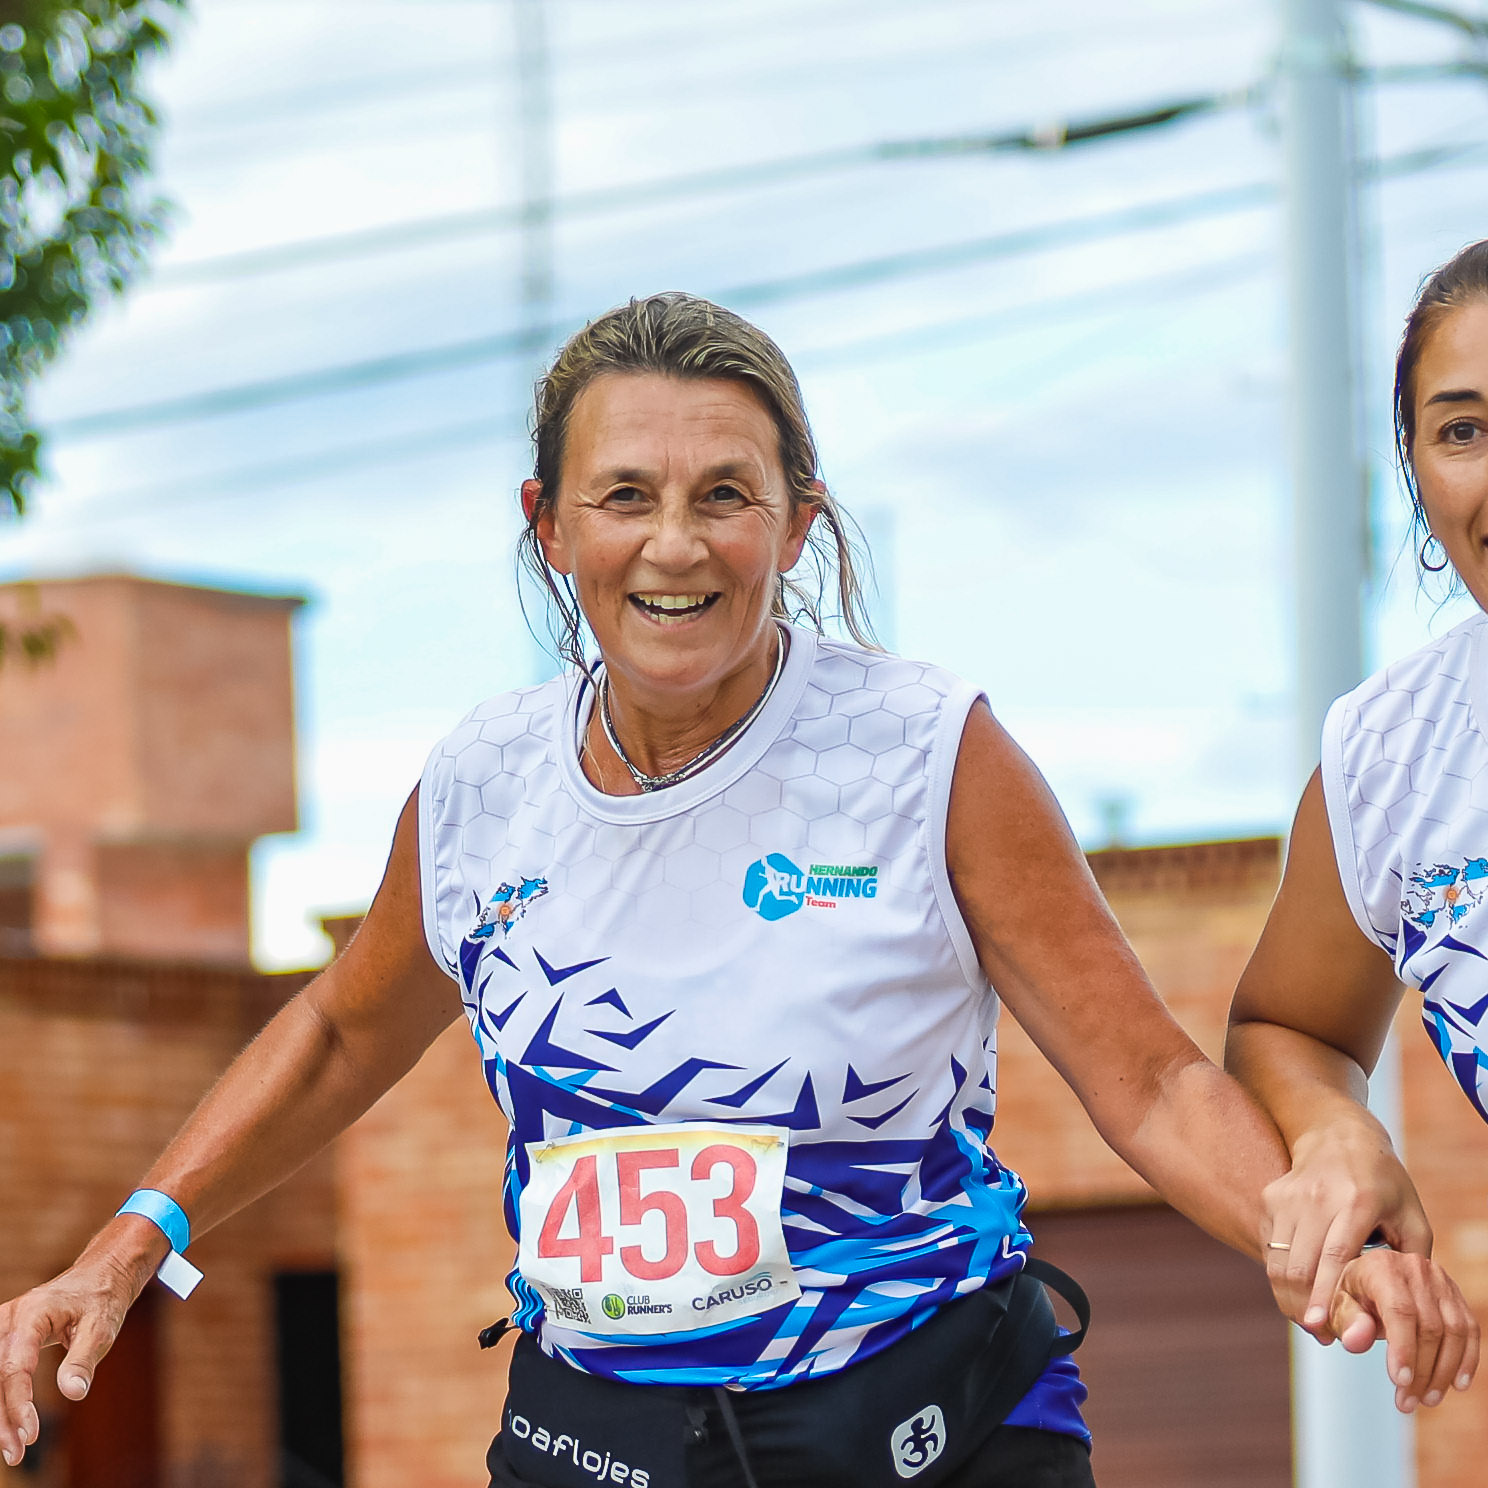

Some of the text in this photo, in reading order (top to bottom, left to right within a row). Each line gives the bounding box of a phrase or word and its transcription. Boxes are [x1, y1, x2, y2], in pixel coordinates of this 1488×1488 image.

[809, 864, 878, 877] HERNANDO
[773, 871, 878, 898] RUNNING
[805, 896, 836, 908] Team
[538, 1144, 760, 1283] 453
[626, 1295, 650, 1305] CLUB
[691, 1277, 772, 1311] CARUSO
[627, 1304, 672, 1315] RUNNER'S
